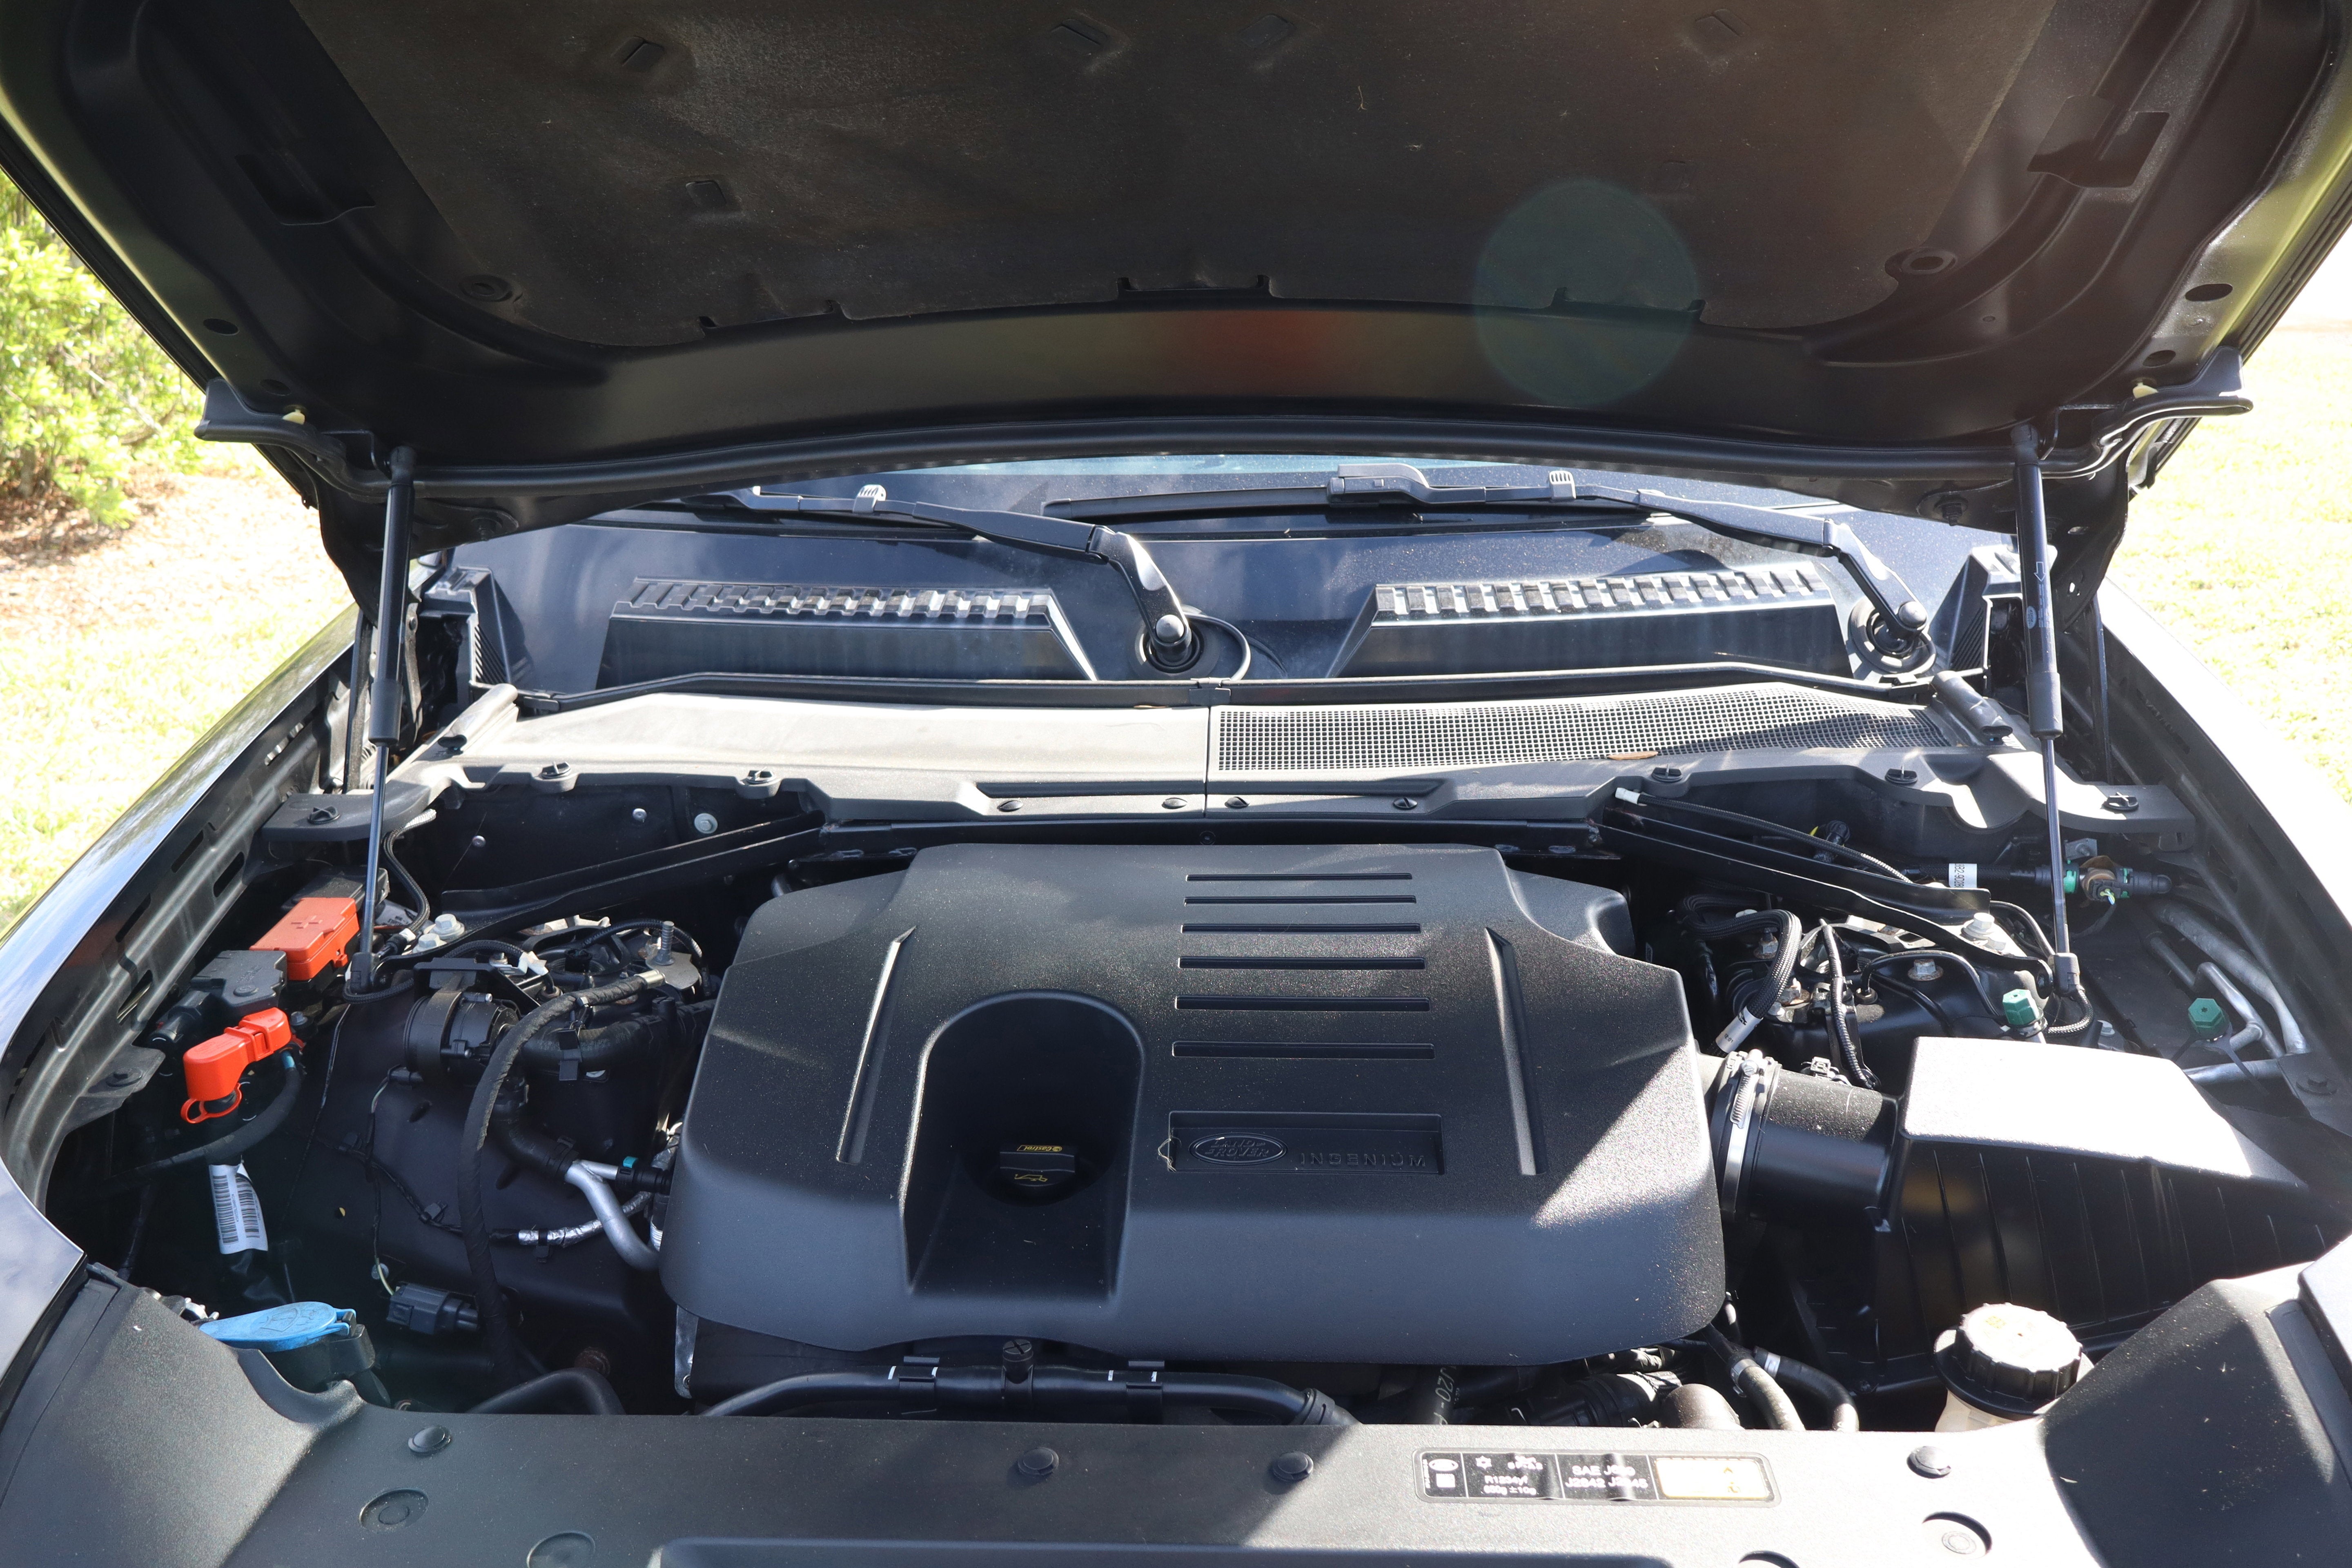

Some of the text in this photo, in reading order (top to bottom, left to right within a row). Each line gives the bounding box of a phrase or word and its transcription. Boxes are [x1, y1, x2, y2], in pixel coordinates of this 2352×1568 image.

[1215, 1147, 1270, 1158] ROVER
[1301, 1153, 1426, 1167] INGENIUM
[1572, 1465, 1601, 1476] SAE
